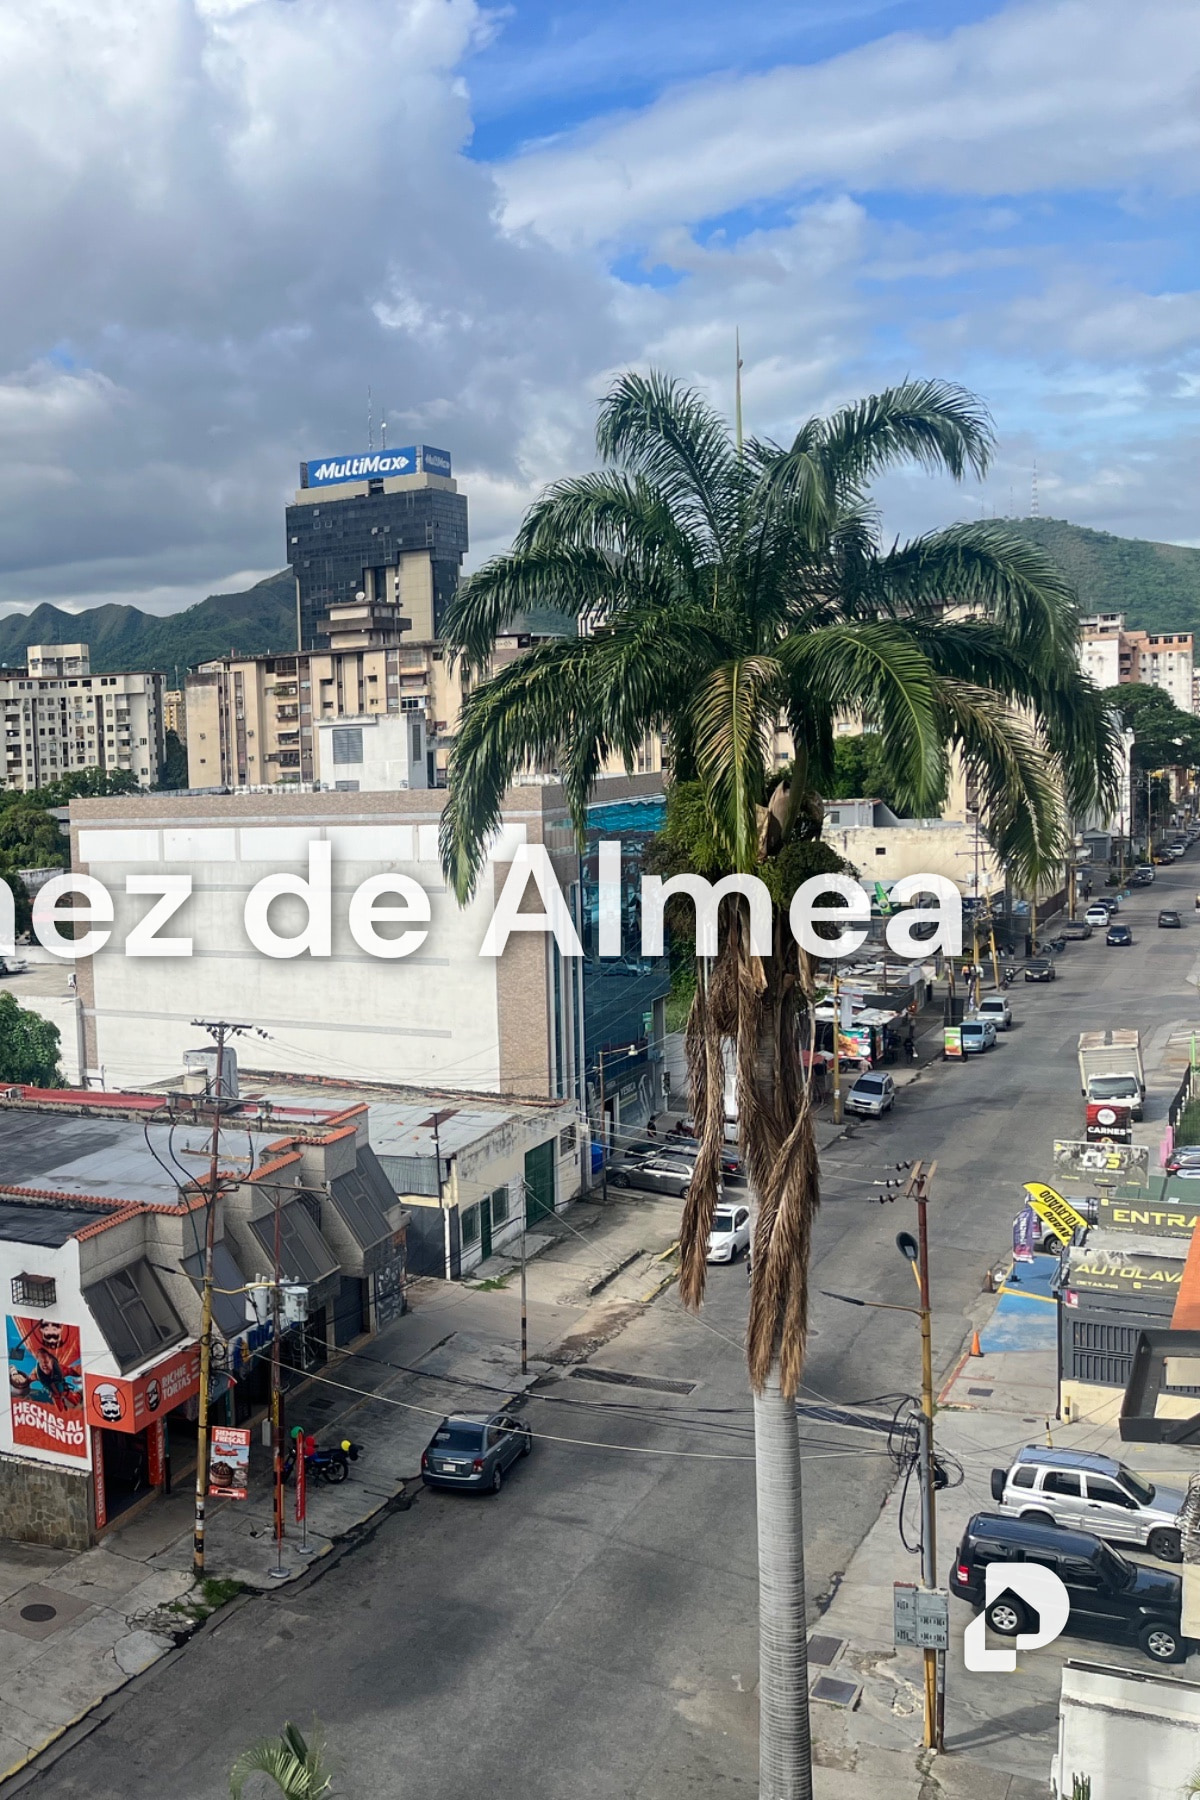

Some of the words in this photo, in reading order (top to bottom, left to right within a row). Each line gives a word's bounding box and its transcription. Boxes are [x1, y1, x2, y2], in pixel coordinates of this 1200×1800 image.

[318, 456, 401, 480] MultiMax
[1087, 1126, 1126, 1136] CARNES
[1040, 1190, 1081, 1229] TOLAVADO
[162, 1363, 187, 1388] RICHIE
[163, 1373, 192, 1400] TORTAS
[13, 1403, 65, 1431] HECHAS
[67, 1420, 83, 1433] AL
[14, 1415, 85, 1445] MOMENTO
